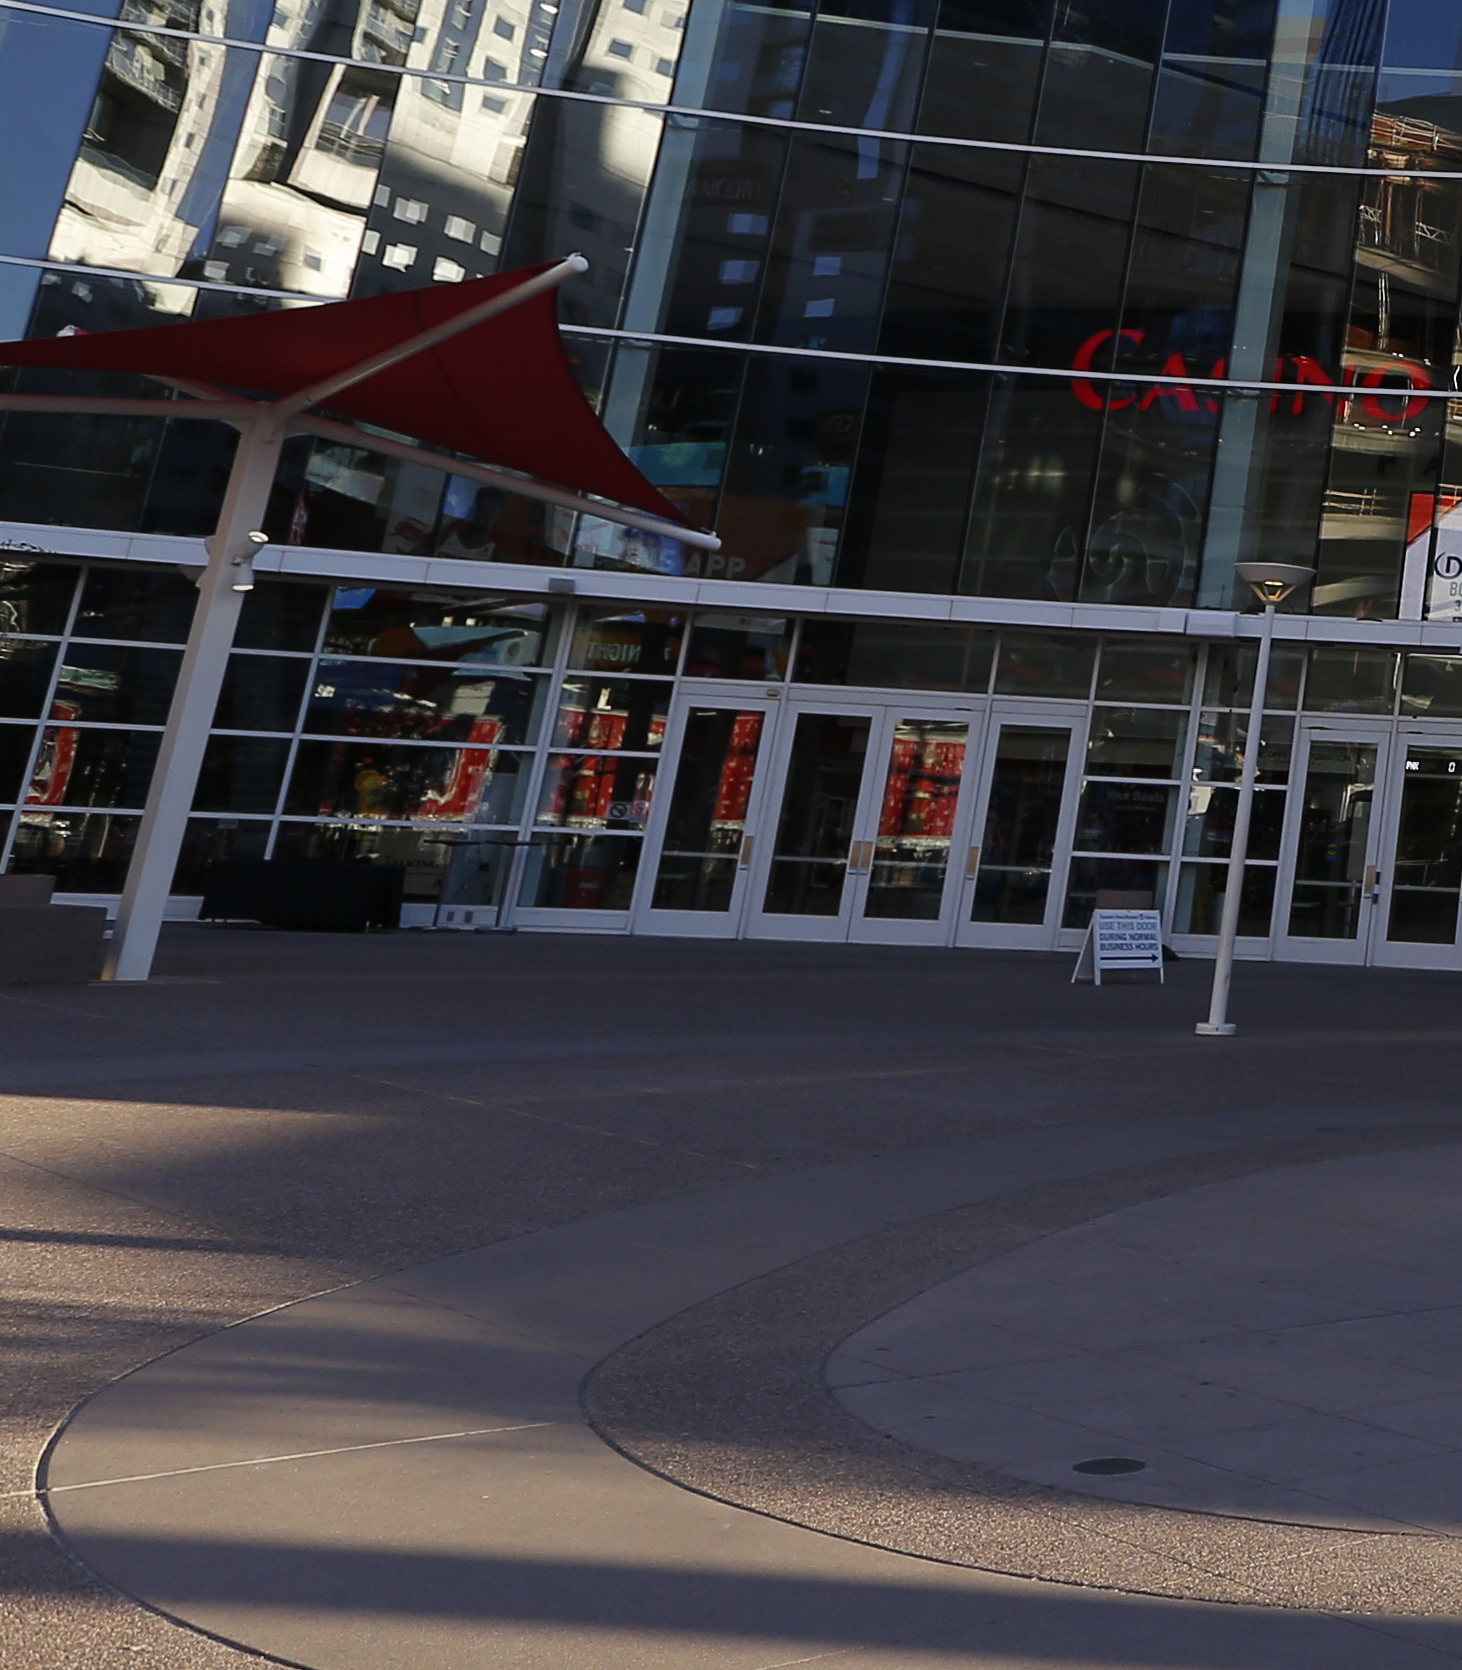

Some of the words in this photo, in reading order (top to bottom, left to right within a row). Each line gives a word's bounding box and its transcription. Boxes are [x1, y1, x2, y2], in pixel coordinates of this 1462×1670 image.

[1454, 600, 1460, 612] 3
[1136, 922, 1157, 930] DOOR
[1100, 933, 1127, 941] DURING
[1128, 933, 1158, 941] NORMAL
[1100, 942, 1133, 951] BUSINESS
[1135, 943, 1158, 951] HOURS
